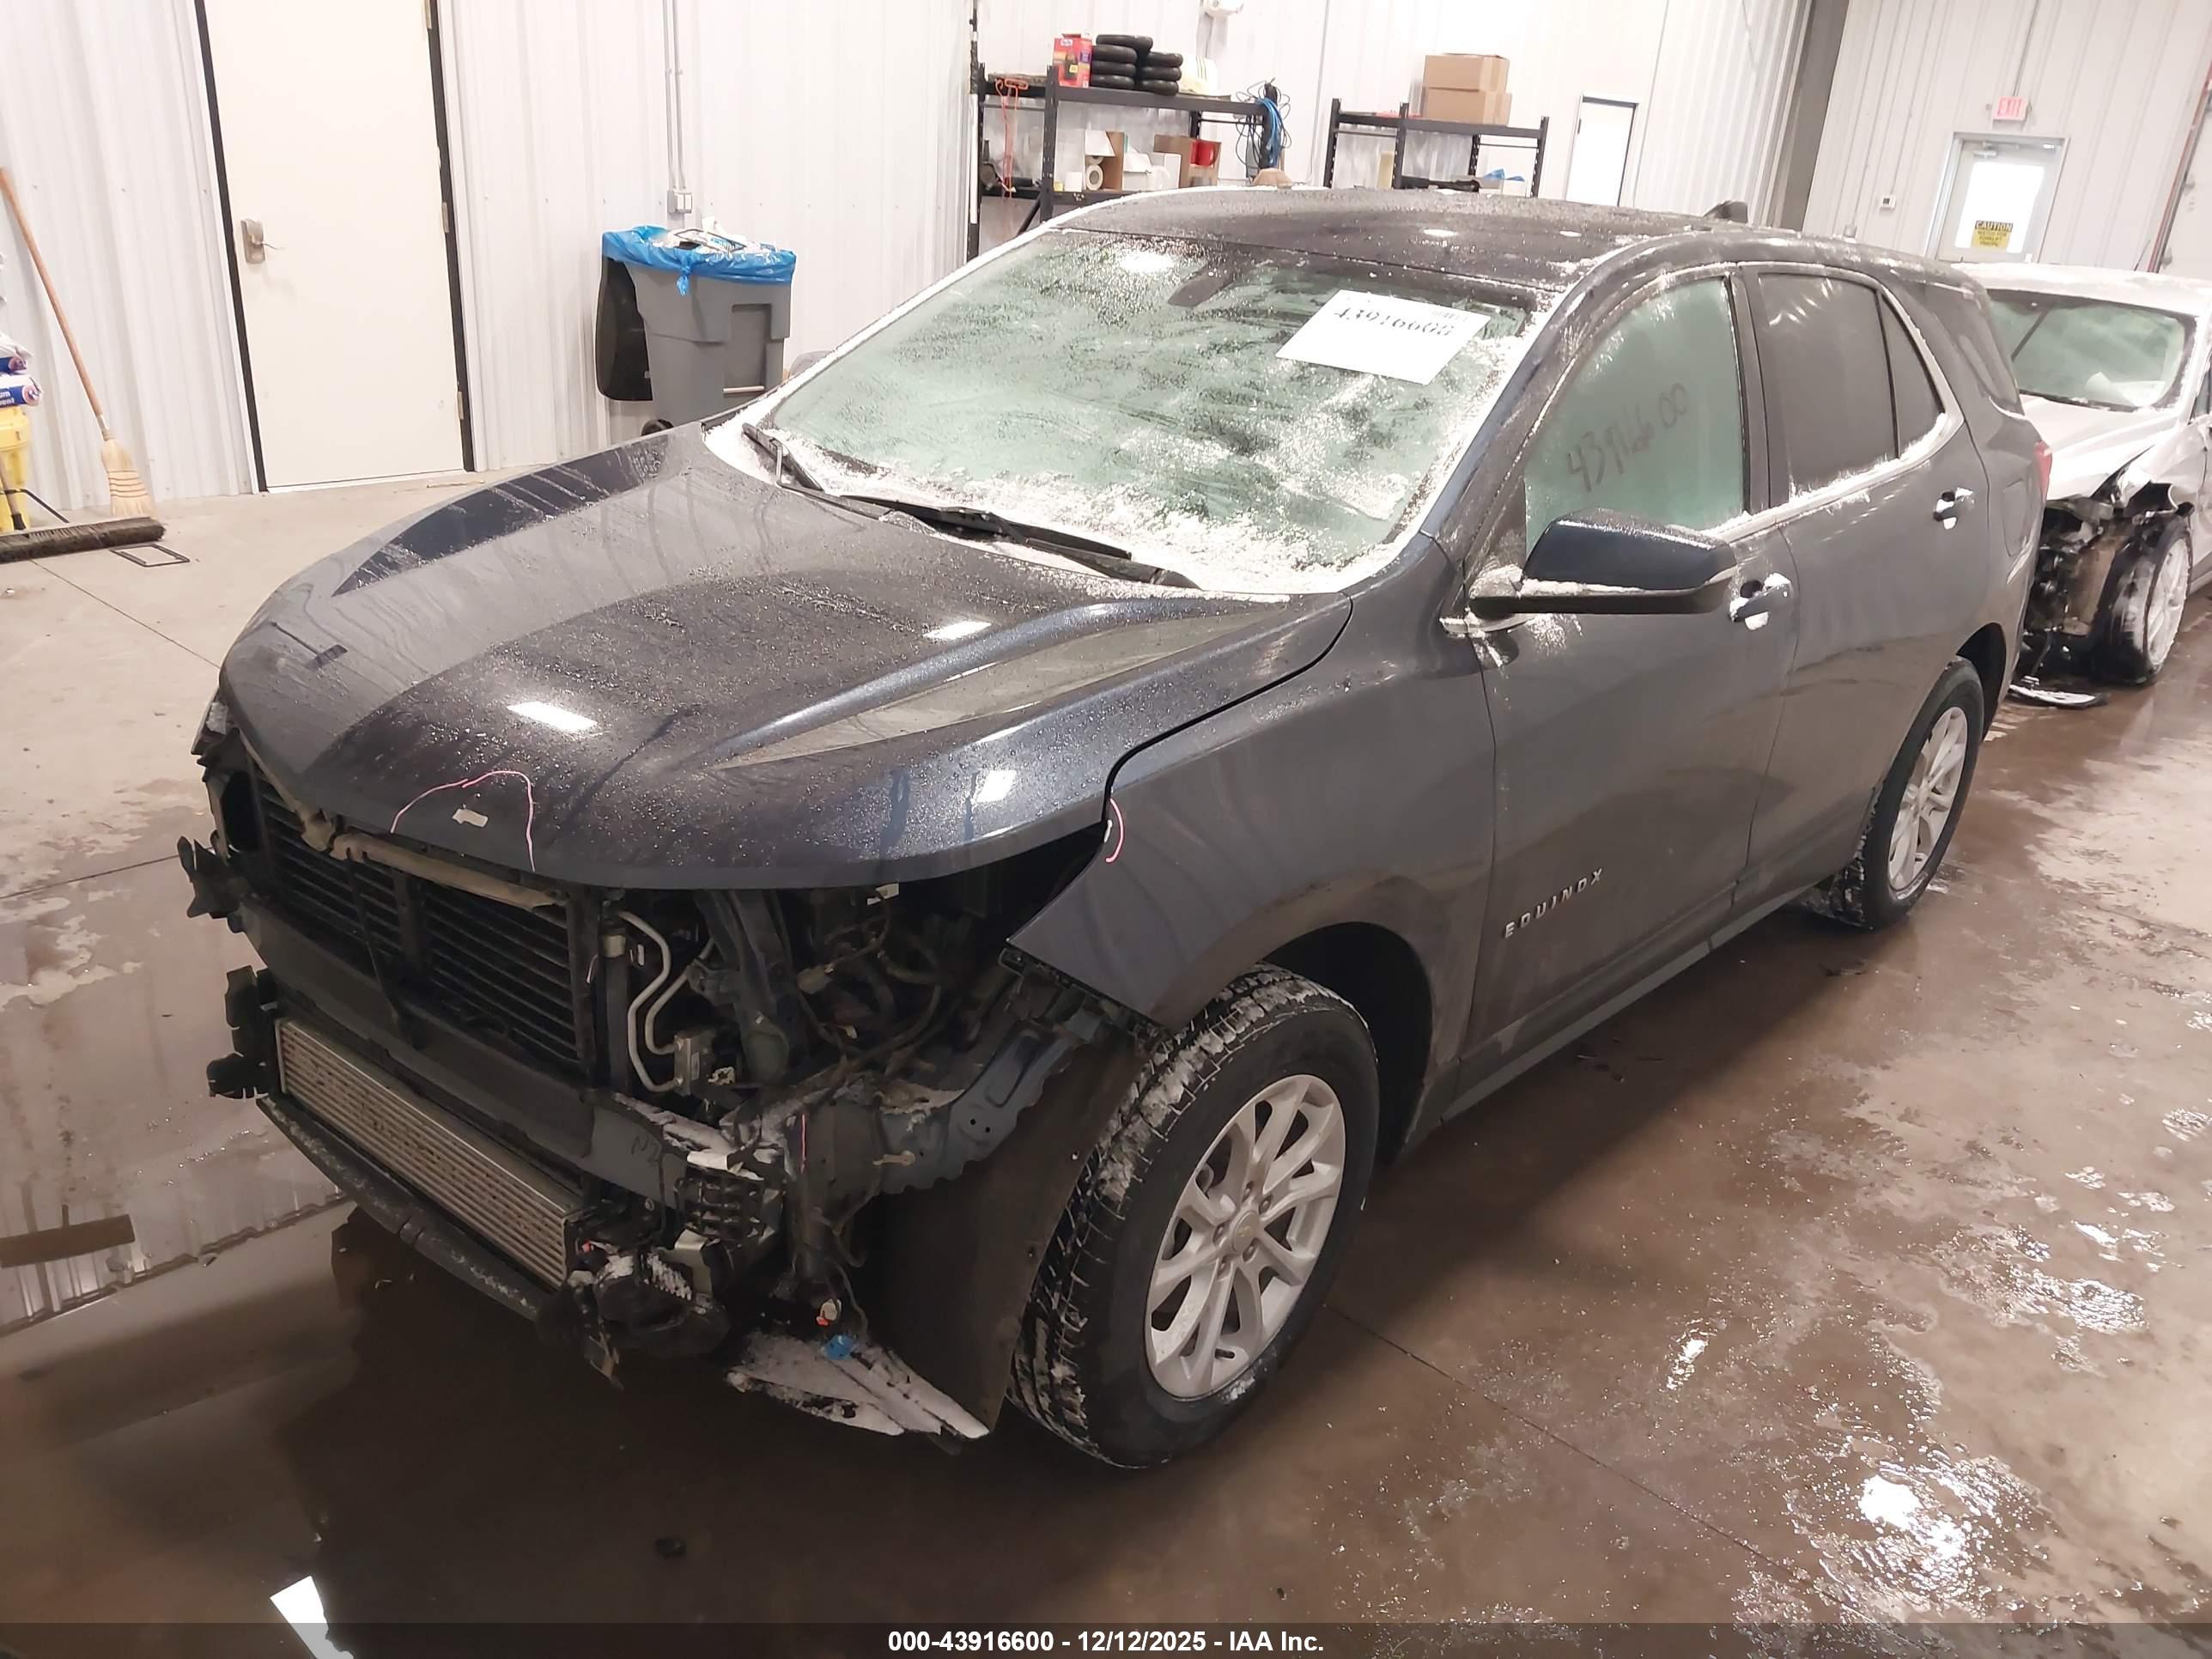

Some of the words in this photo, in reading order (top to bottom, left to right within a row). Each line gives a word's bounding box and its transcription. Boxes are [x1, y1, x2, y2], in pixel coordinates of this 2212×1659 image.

[1997, 97, 2021, 117] EXIT
[1977, 221, 2013, 233] CAUTION
[1504, 867, 1603, 939] EQUINOX
